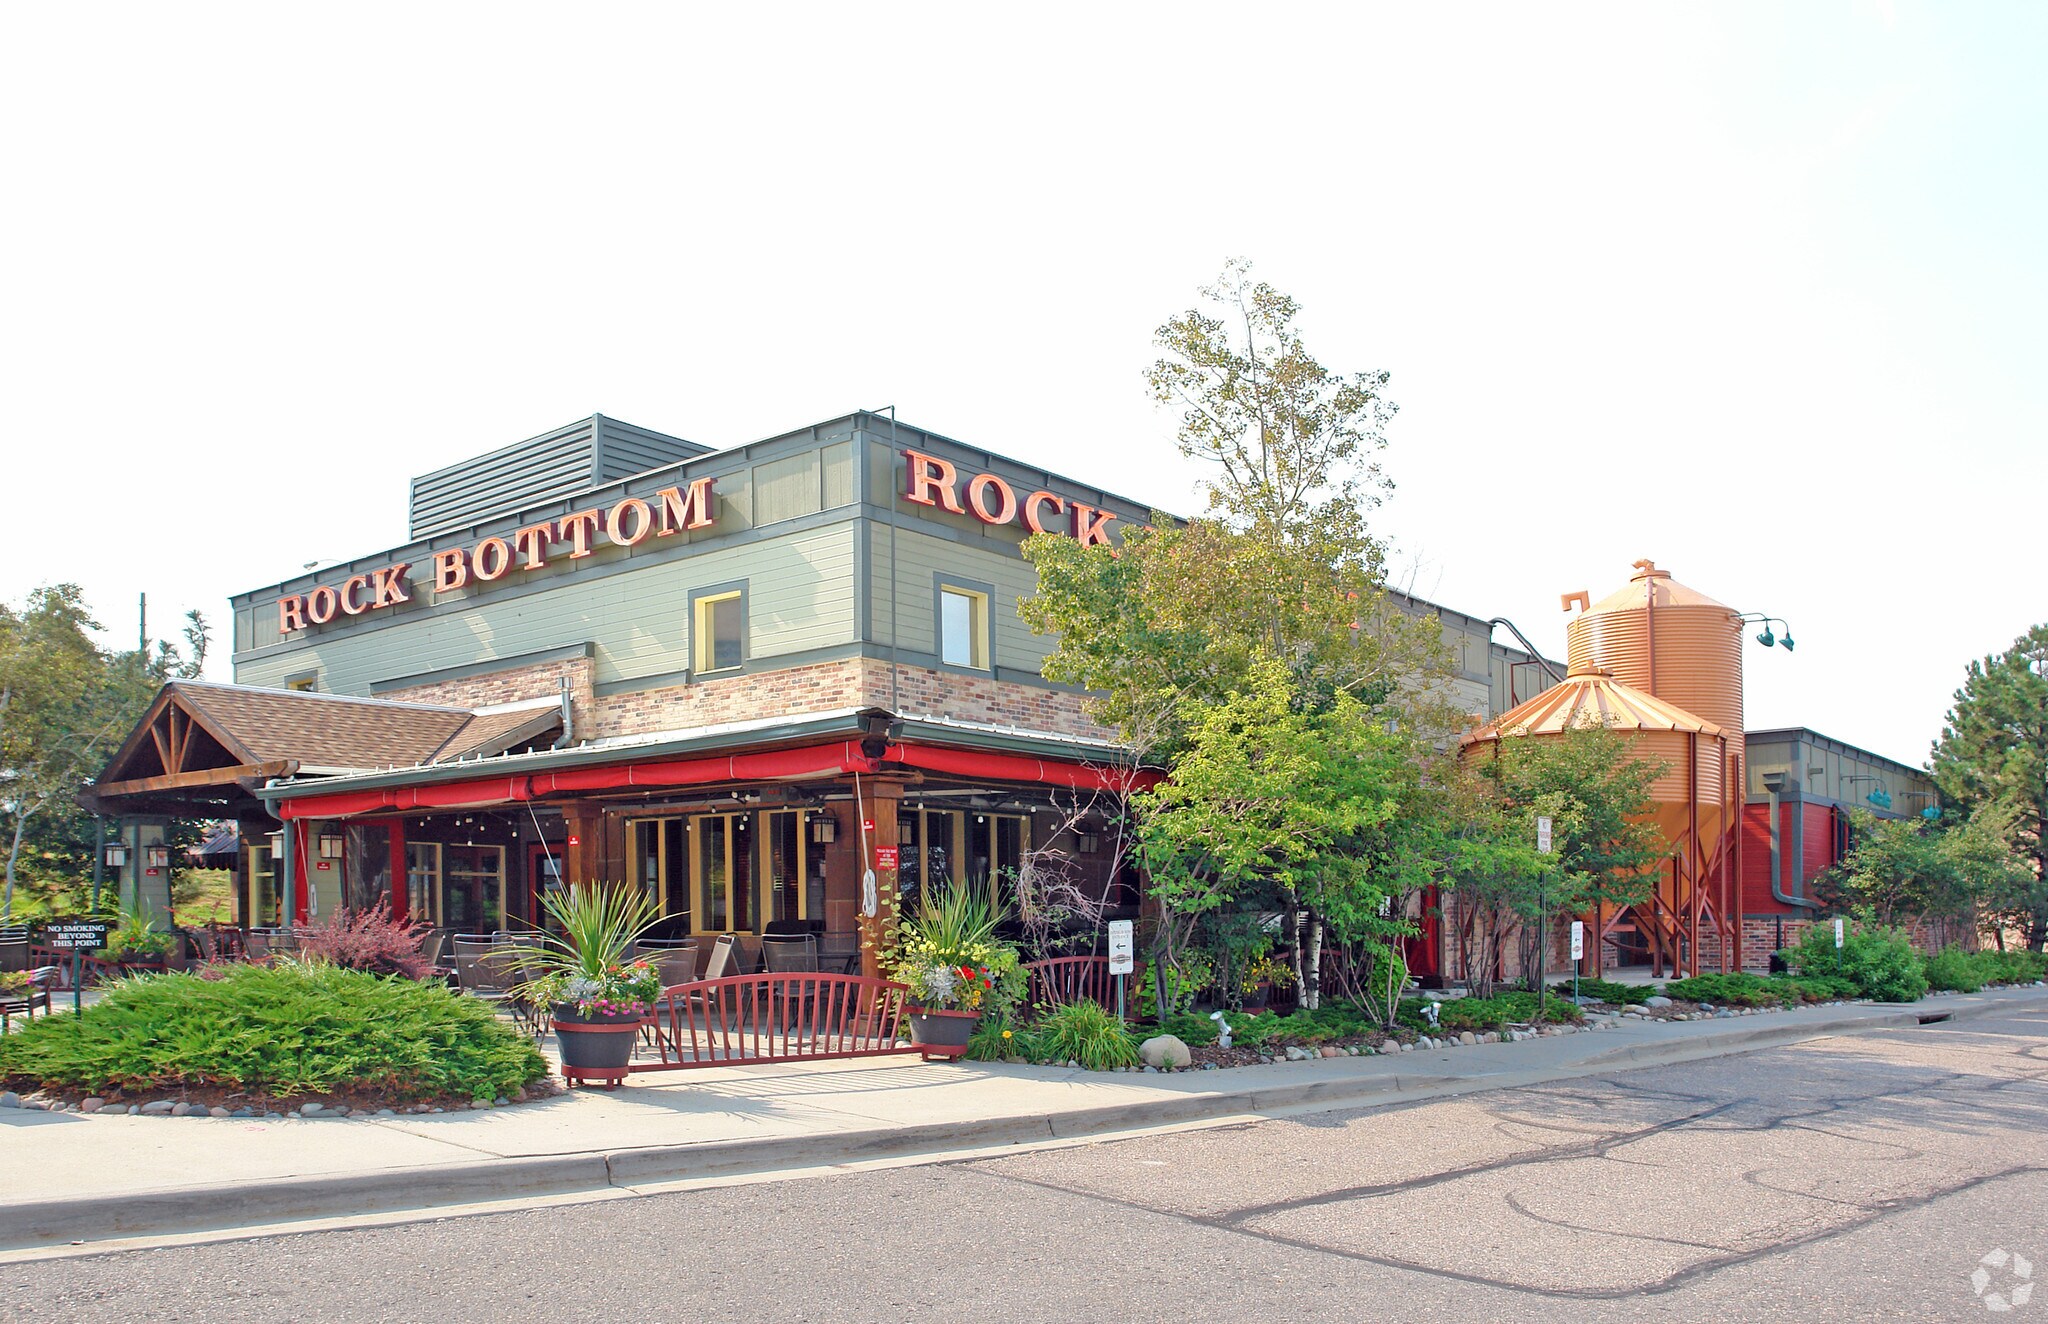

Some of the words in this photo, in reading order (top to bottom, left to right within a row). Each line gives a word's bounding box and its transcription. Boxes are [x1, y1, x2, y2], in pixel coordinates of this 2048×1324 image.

[899, 448, 1119, 559] ROCK
[277, 562, 411, 634] ROCK
[432, 477, 718, 594] BOTTOM
[47, 925, 62, 933] NO
[62, 924, 105, 933] SMOKING
[57, 932, 96, 940] BEYOND
[51, 939, 73, 947] THIS
[74, 939, 102, 947] POINT
